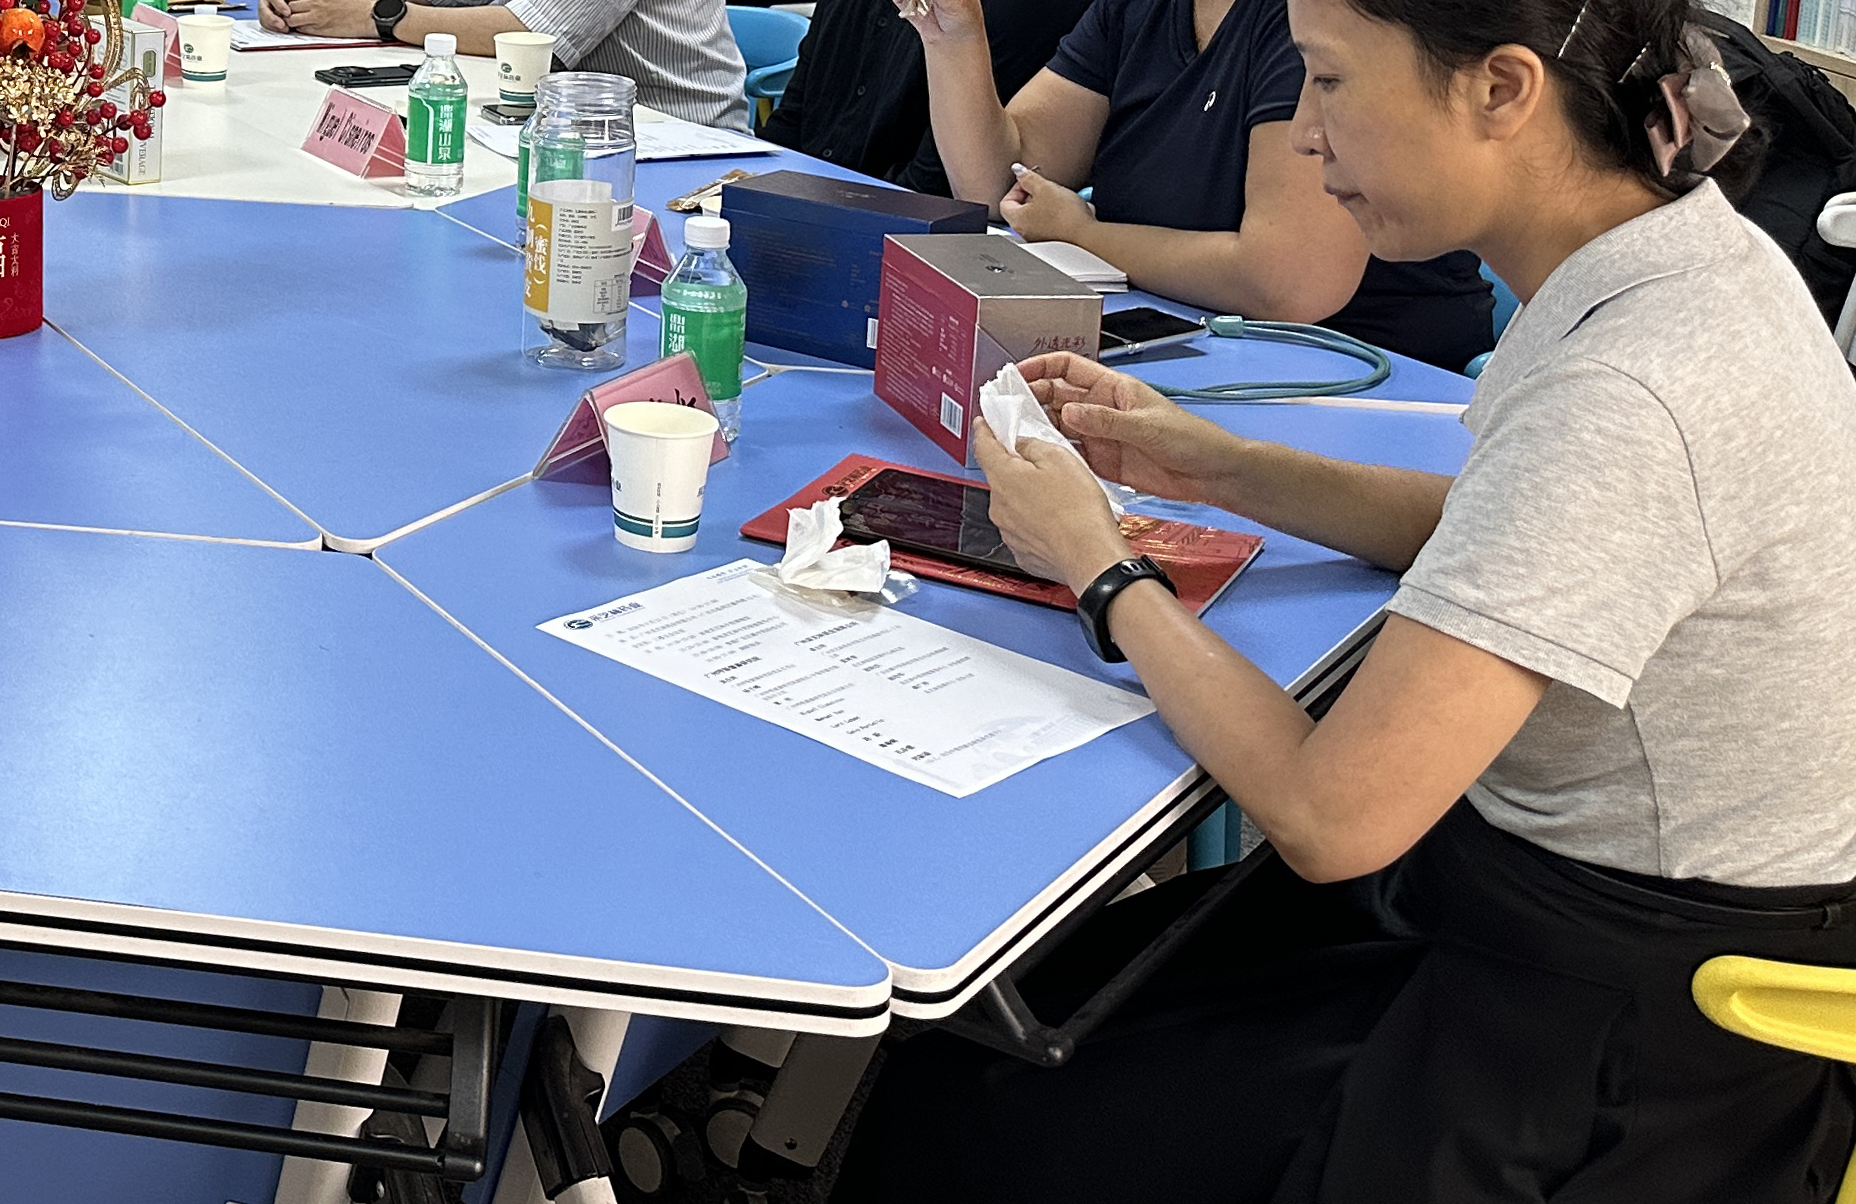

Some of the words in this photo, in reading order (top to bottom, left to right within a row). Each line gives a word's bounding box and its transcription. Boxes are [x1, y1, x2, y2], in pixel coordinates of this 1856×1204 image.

[316, 102, 348, 142] Miguel
[437, 104, 454, 161] 鼎湖山泉
[668, 313, 686, 353] 鼎湖
